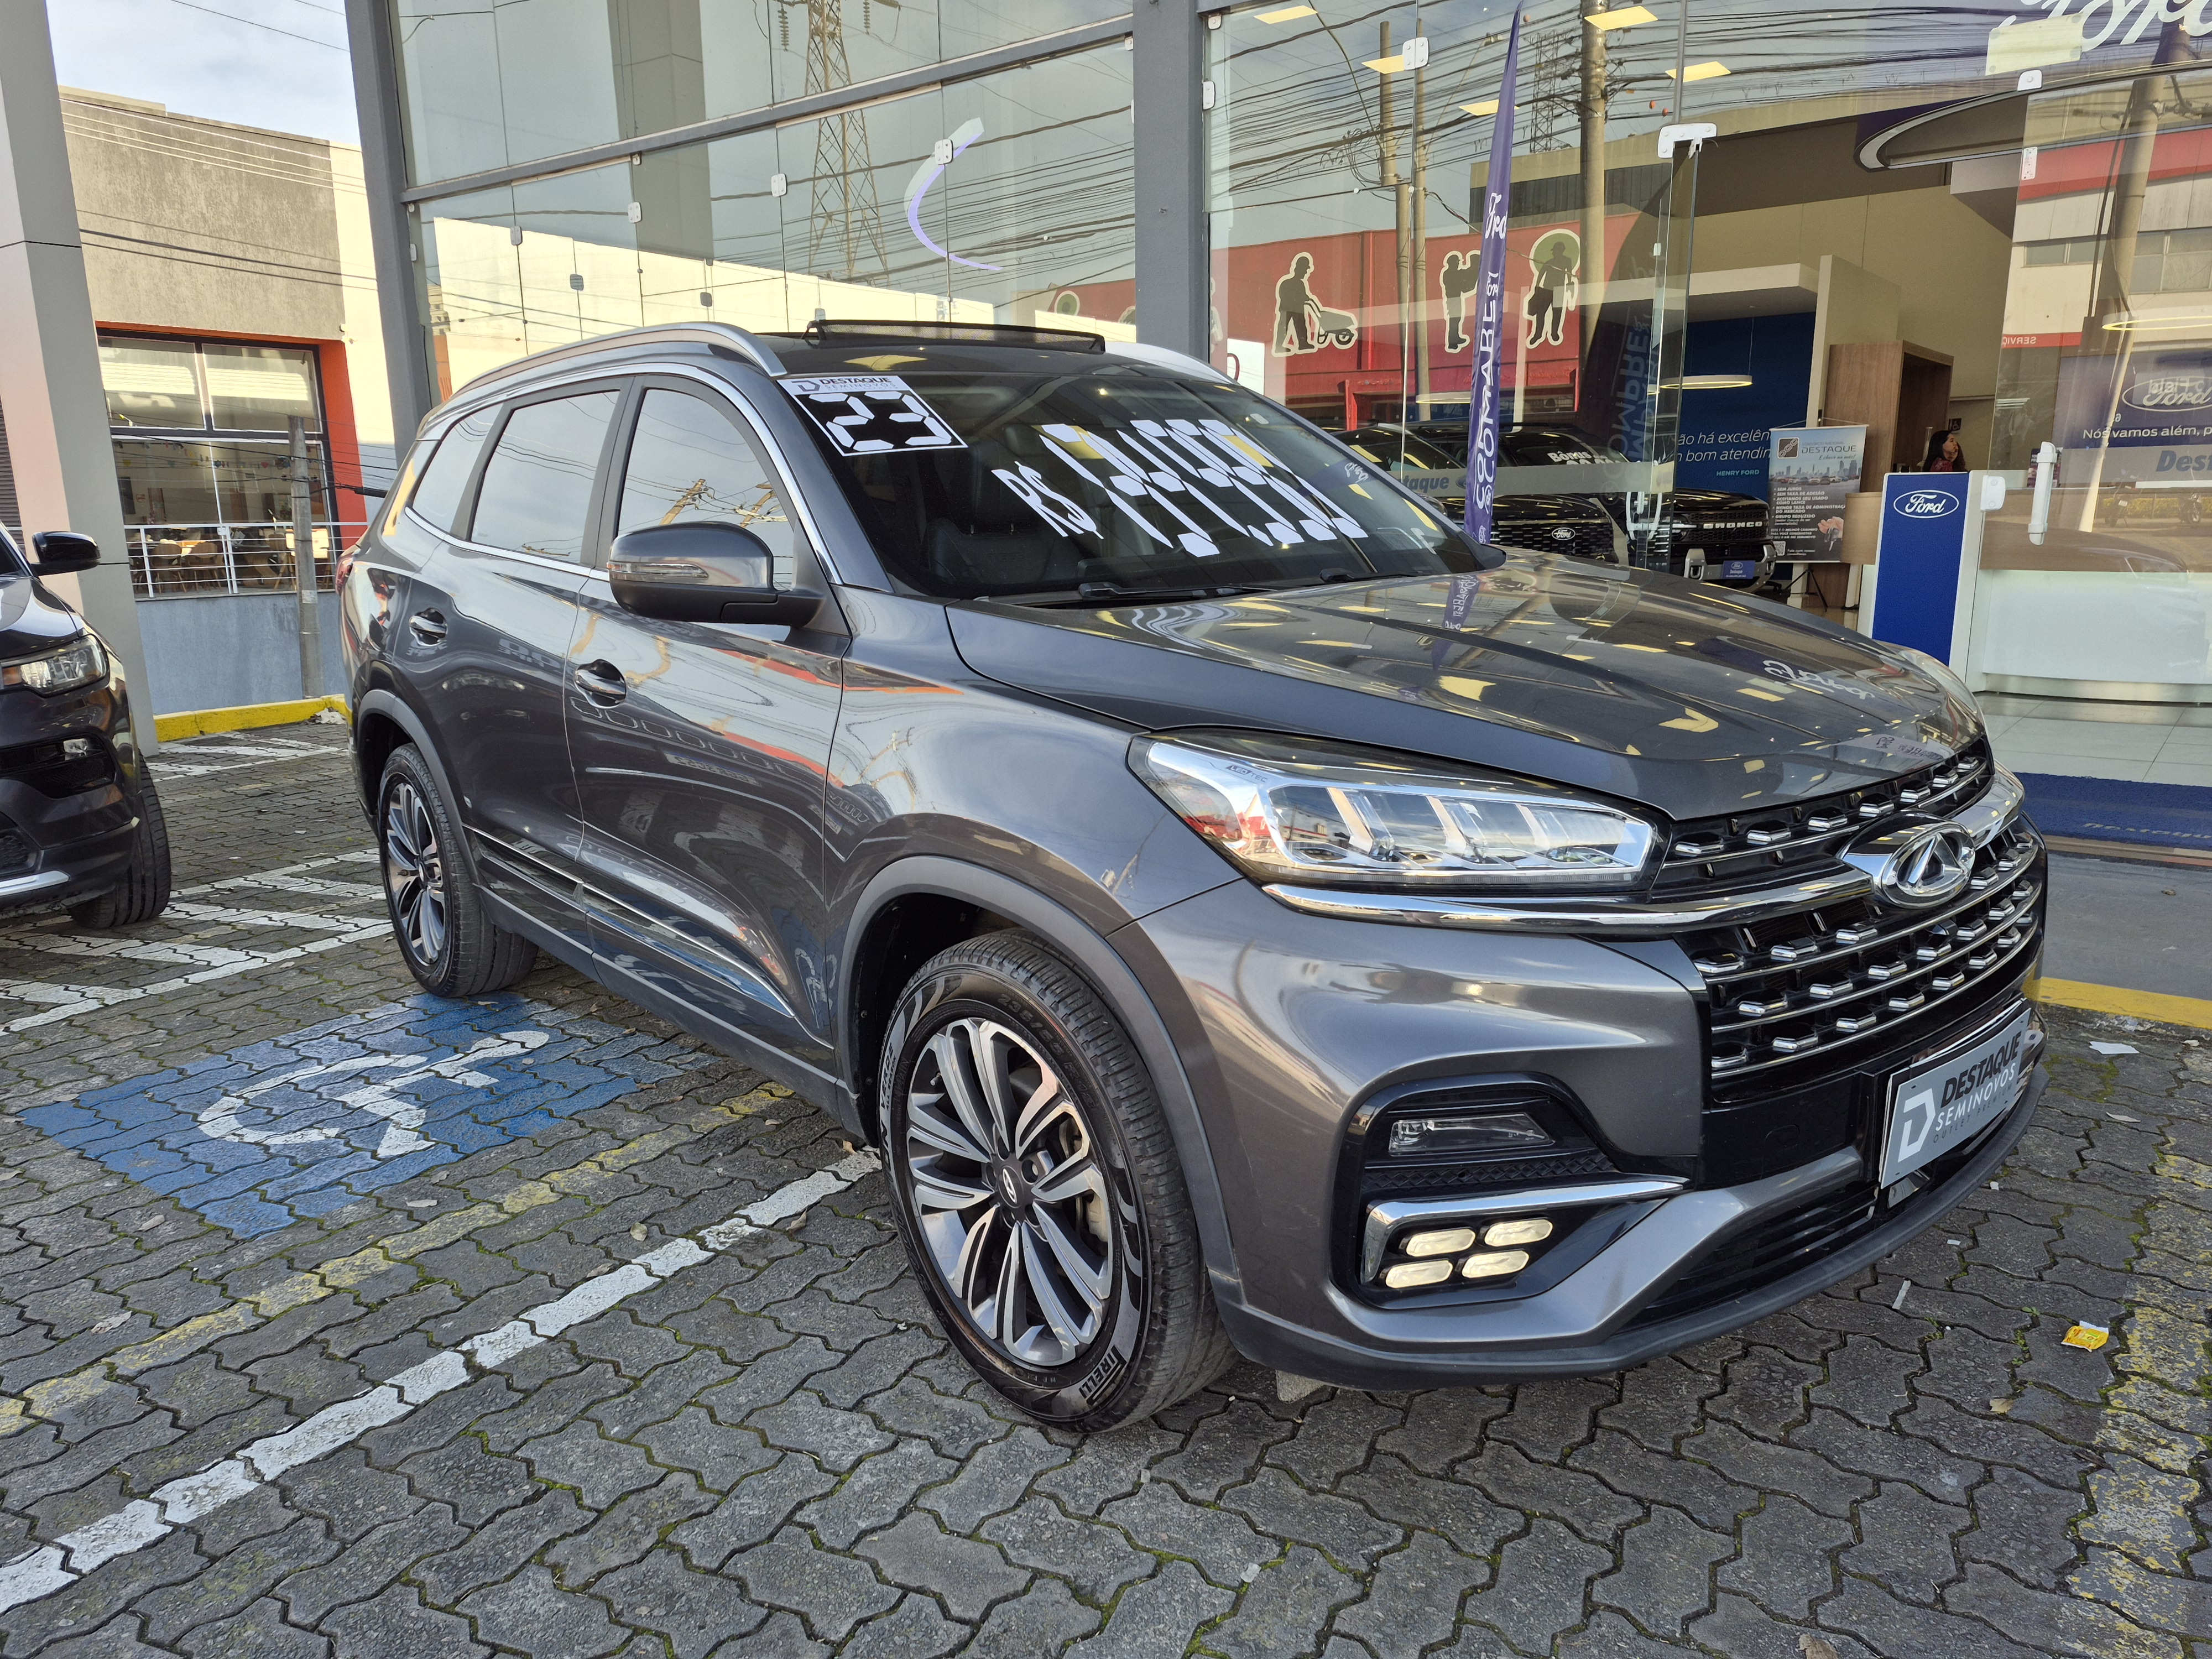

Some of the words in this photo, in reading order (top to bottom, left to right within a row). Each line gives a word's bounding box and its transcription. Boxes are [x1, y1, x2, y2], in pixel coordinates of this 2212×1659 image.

[808, 390, 952, 451] 23
[1697, 431, 1714, 444] há
[2083, 426, 2110, 439] Nós
[2112, 426, 2158, 437] vamos
[2161, 424, 2200, 436] além,
[1547, 451, 1592, 462] Bônus
[1686, 450, 1717, 462] bom
[1801, 445, 1856, 453] DESTAQUE
[1400, 476, 1449, 493] taque
[991, 461, 1104, 539] R$
[1905, 493, 1947, 513] Ford
[1556, 529, 1572, 539] Ford
[1230, 765, 1248, 775] LED
[1250, 773, 1269, 783] TEC
[881, 1042, 894, 1109] VERDE
[888, 1055, 896, 1091] SEASON
[1940, 1031, 2022, 1108] DESTAQUE
[1936, 1063, 2016, 1131] SEMINOVOS
[1933, 1114, 1971, 1144] OUTLET
[1078, 1344, 1128, 1406] PIRELLI
